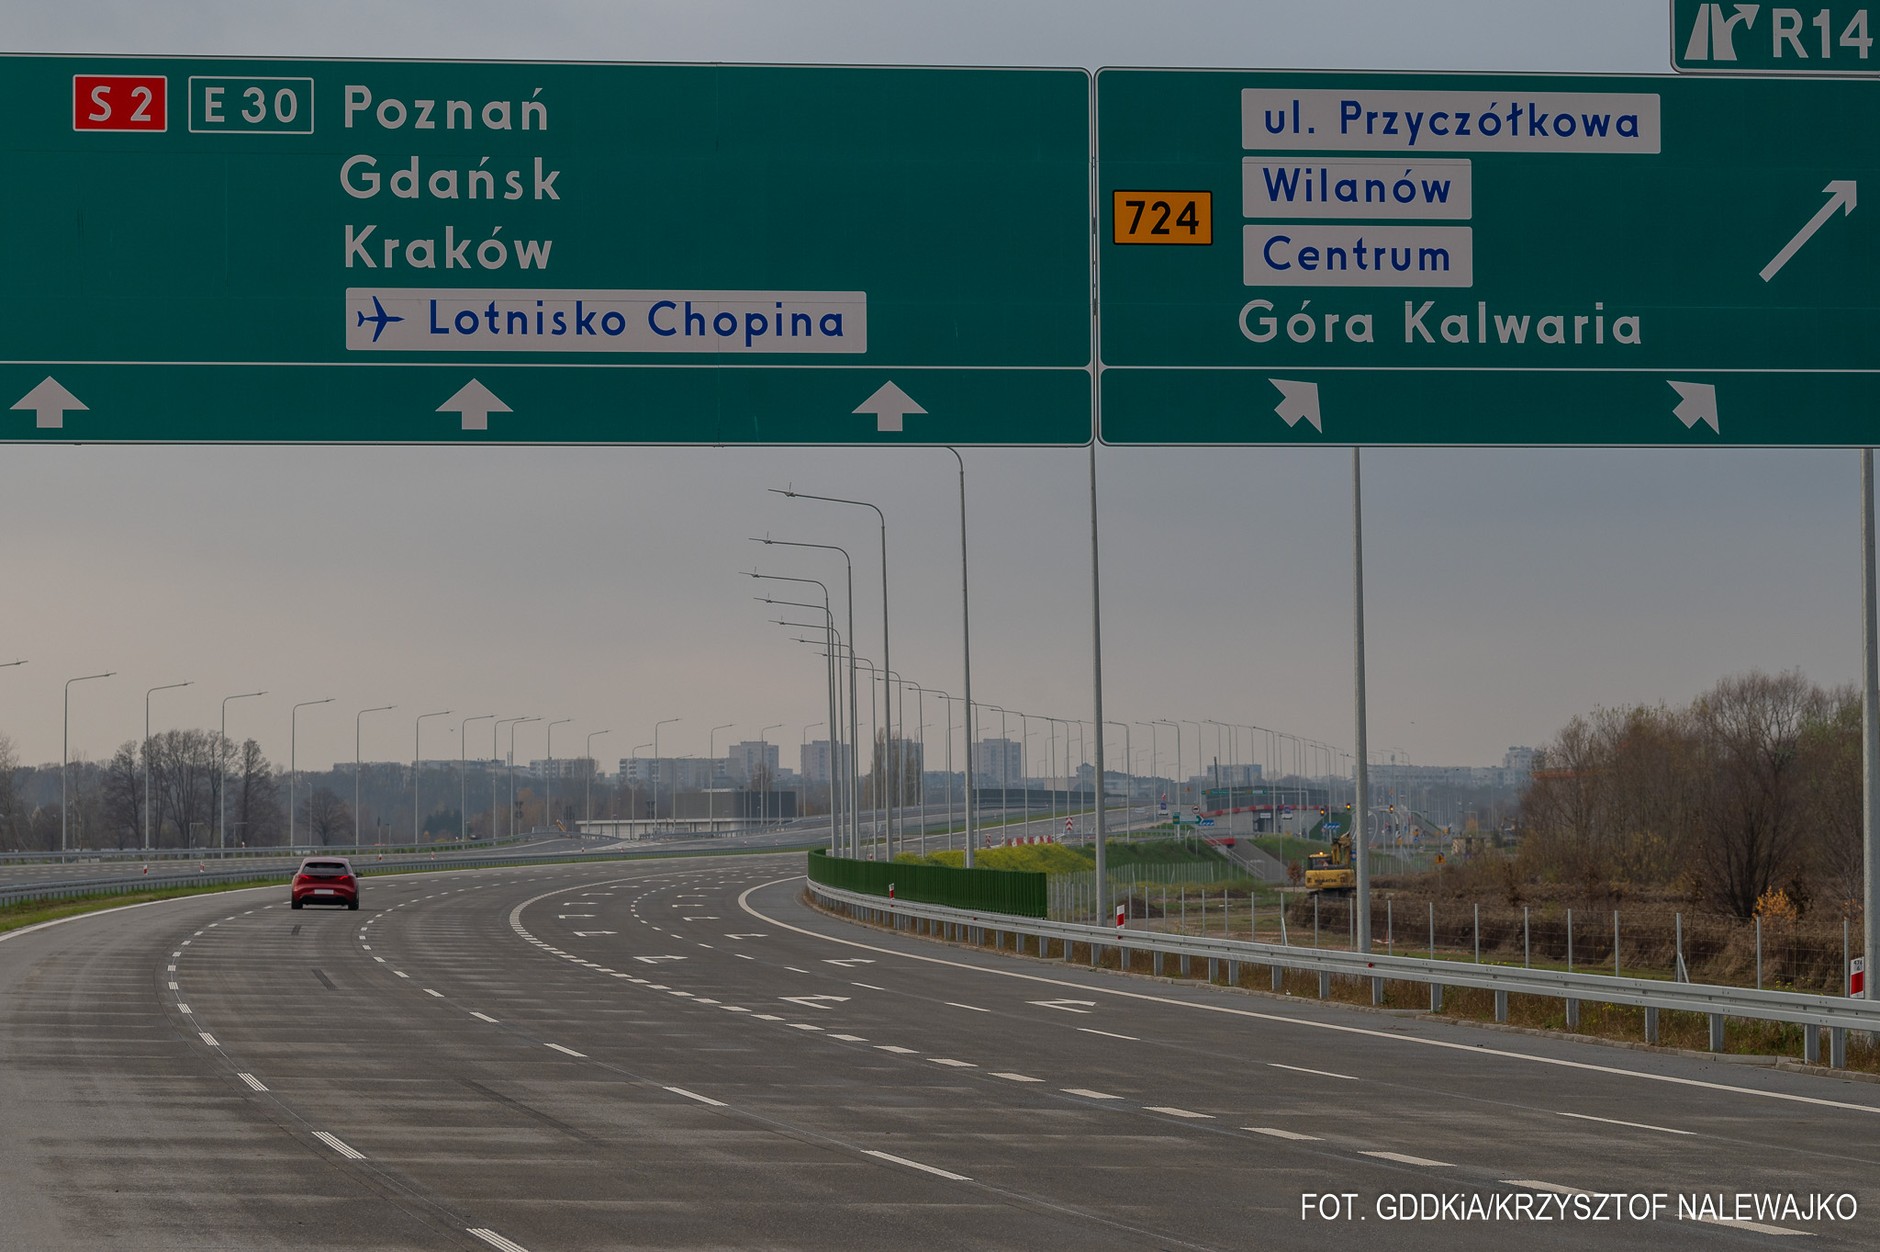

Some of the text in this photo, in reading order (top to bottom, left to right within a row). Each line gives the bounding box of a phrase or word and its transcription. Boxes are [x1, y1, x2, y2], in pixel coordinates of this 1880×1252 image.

[1772, 8, 1874, 59] R14
[88, 85, 153, 122] S 2
[205, 86, 298, 124] E 30
[344, 85, 547, 131] Poznań
[1264, 99, 1640, 146] ul. Przyczółkowa
[339, 154, 561, 200] Gdańsk
[1262, 167, 1451, 204] Wilanów
[1125, 200, 1200, 235] 724
[345, 224, 553, 270] Kraków
[1263, 235, 1450, 272] Centrum
[429, 299, 844, 348] Lotnisko Chopina
[1238, 299, 1642, 345] Góra Kalwaria
